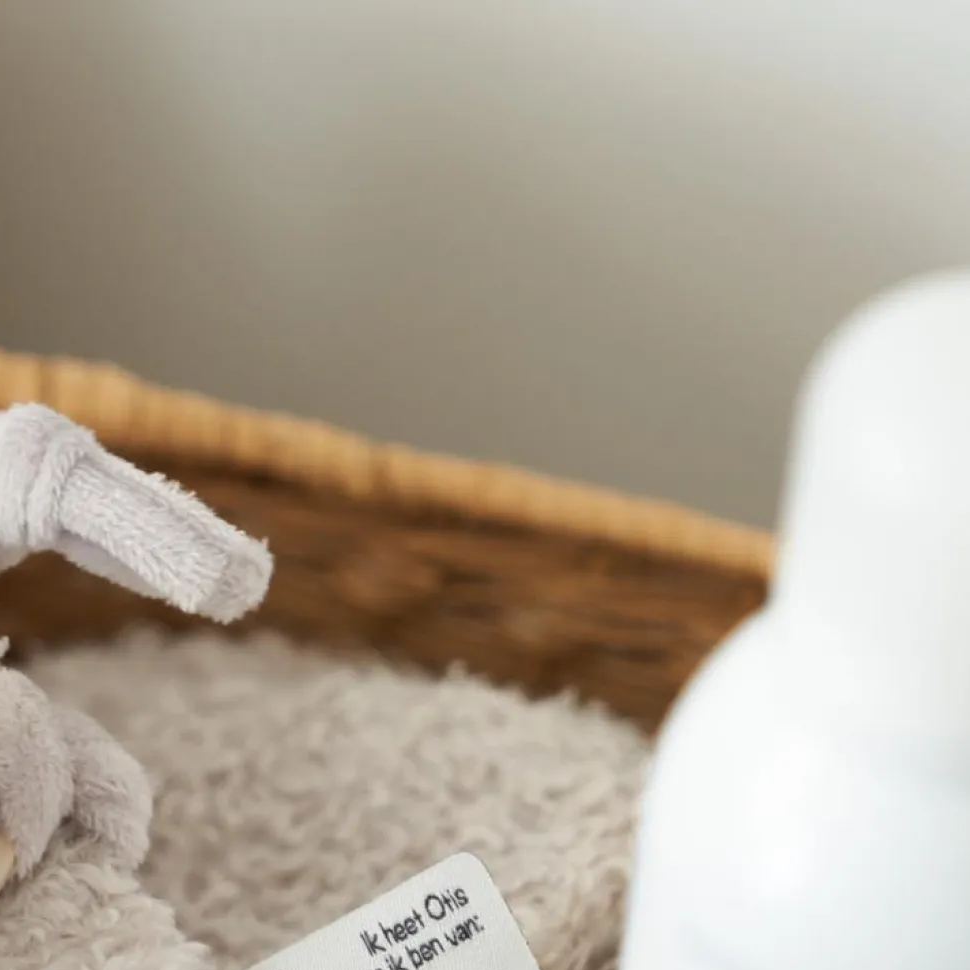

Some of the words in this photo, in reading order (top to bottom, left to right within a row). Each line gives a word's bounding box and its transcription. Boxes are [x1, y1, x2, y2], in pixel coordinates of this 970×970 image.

[359, 929, 387, 957] Ik
[378, 907, 425, 946] heet
[424, 887, 470, 921] Otis
[404, 937, 446, 970] ben
[443, 915, 485, 947] van:
